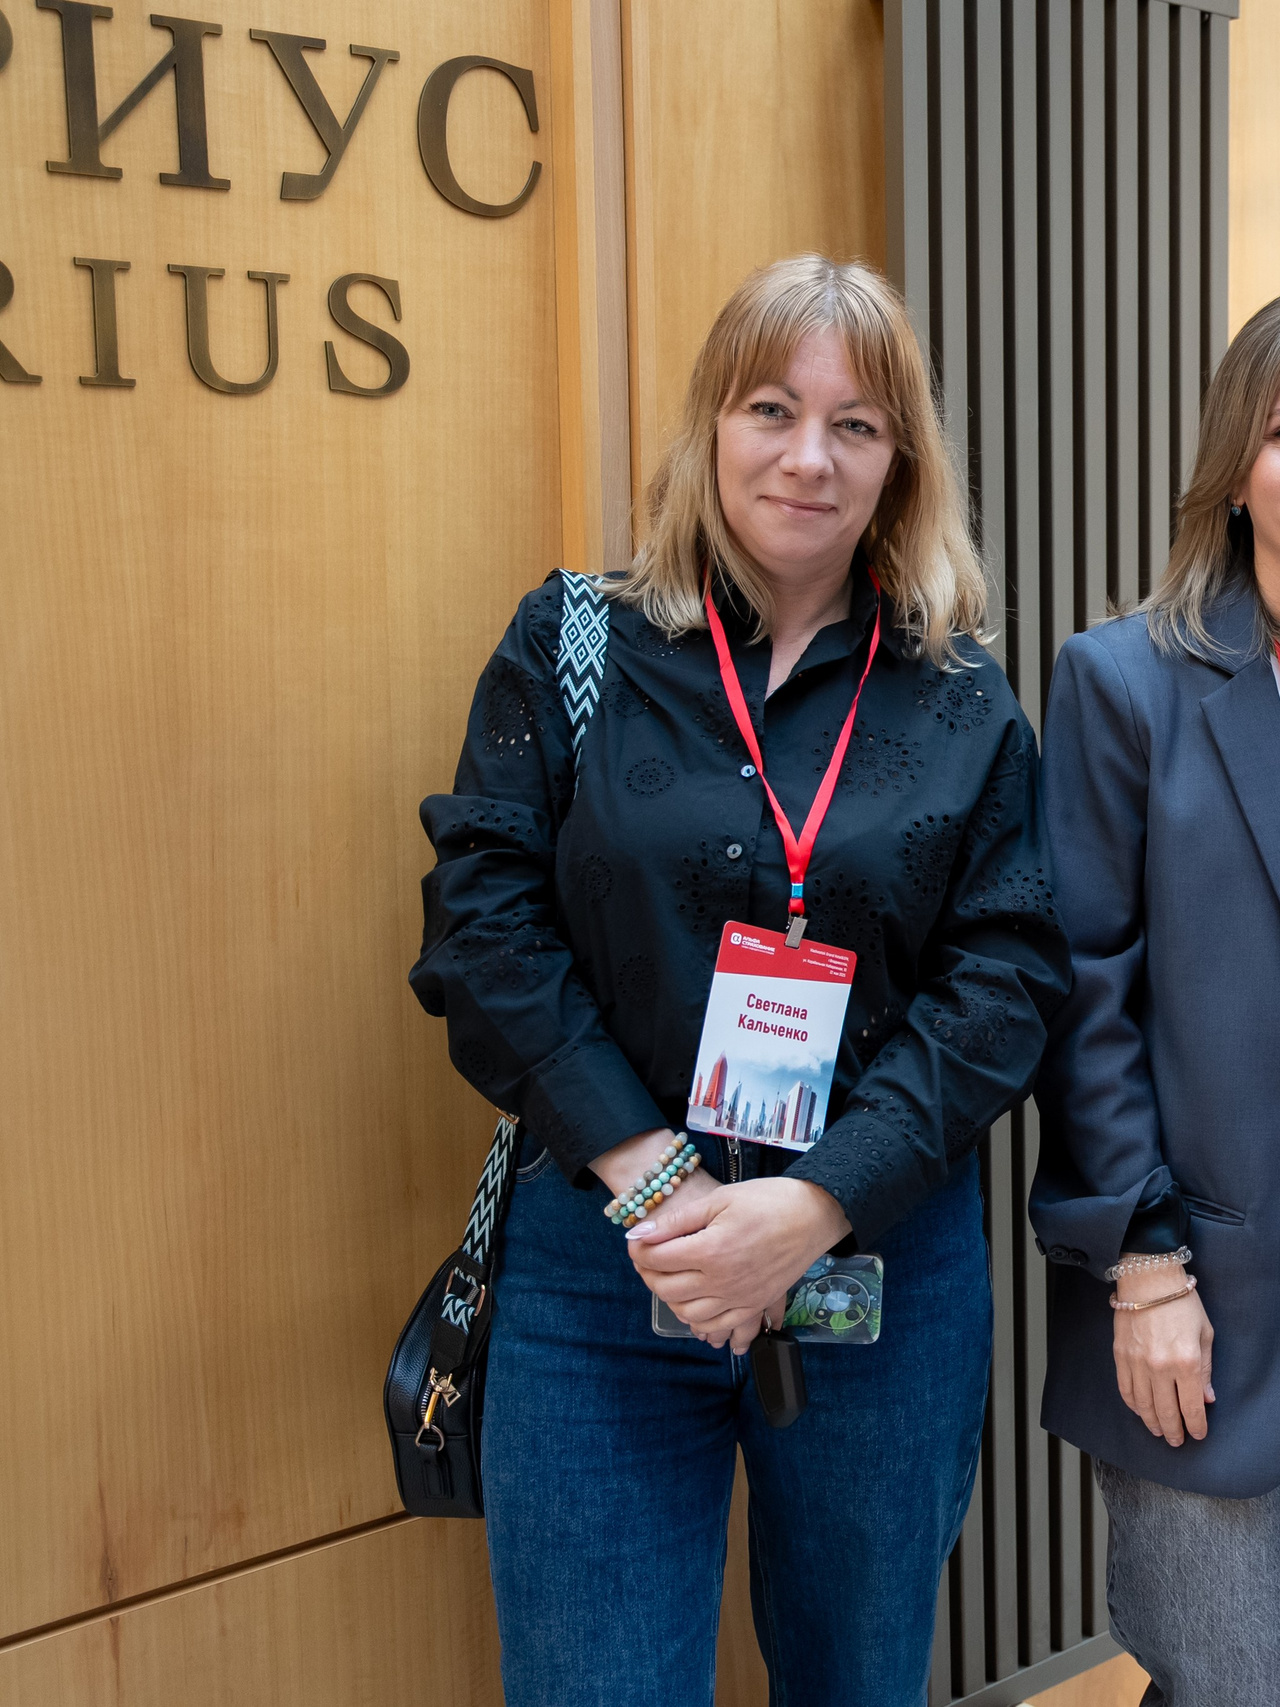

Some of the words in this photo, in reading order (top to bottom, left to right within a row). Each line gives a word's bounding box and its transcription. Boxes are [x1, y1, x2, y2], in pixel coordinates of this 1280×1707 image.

[0, 0, 543, 218] ИУС
[746, 993, 808, 1020] Светлана
[738, 1014, 808, 1042] Кальченко
